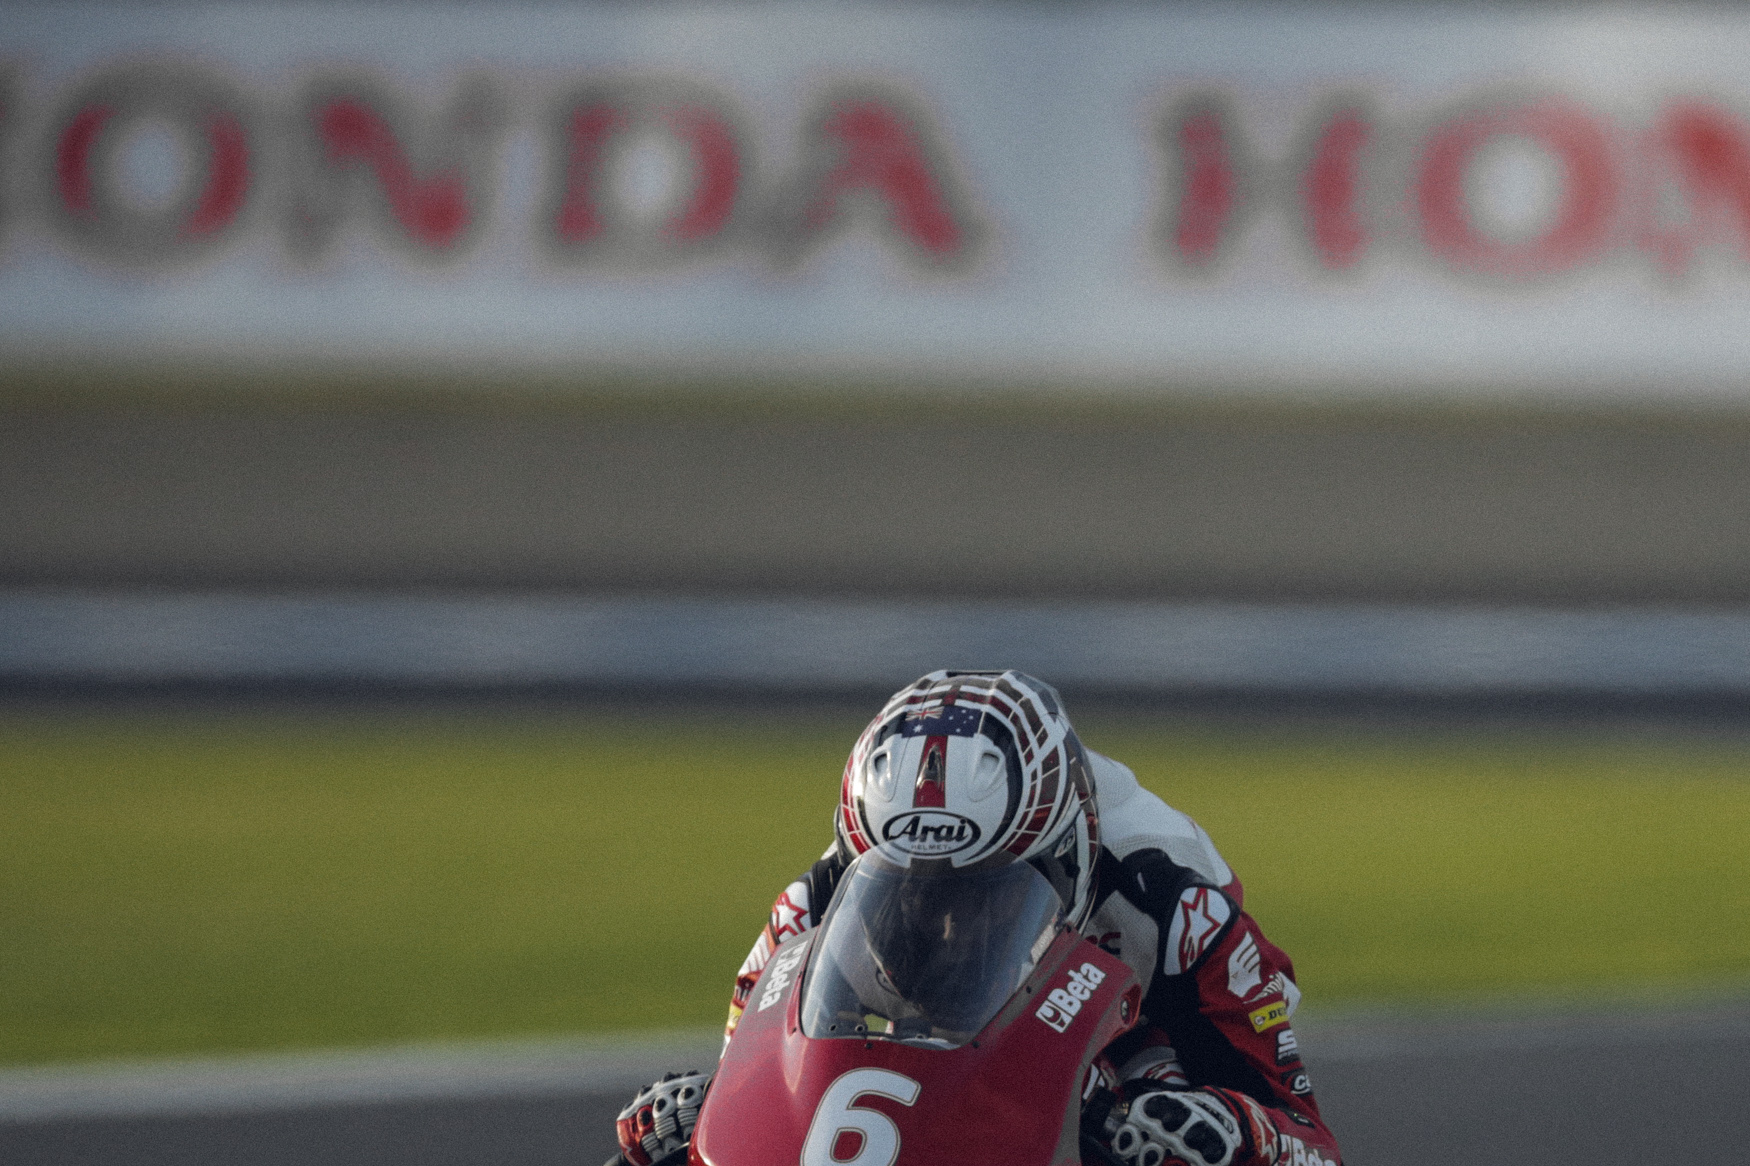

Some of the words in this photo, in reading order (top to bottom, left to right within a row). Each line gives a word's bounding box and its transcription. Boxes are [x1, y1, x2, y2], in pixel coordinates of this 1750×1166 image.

[0, 70, 990, 275] ONDA
[886, 814, 968, 843] Arai
[1048, 961, 1107, 1017] Beta
